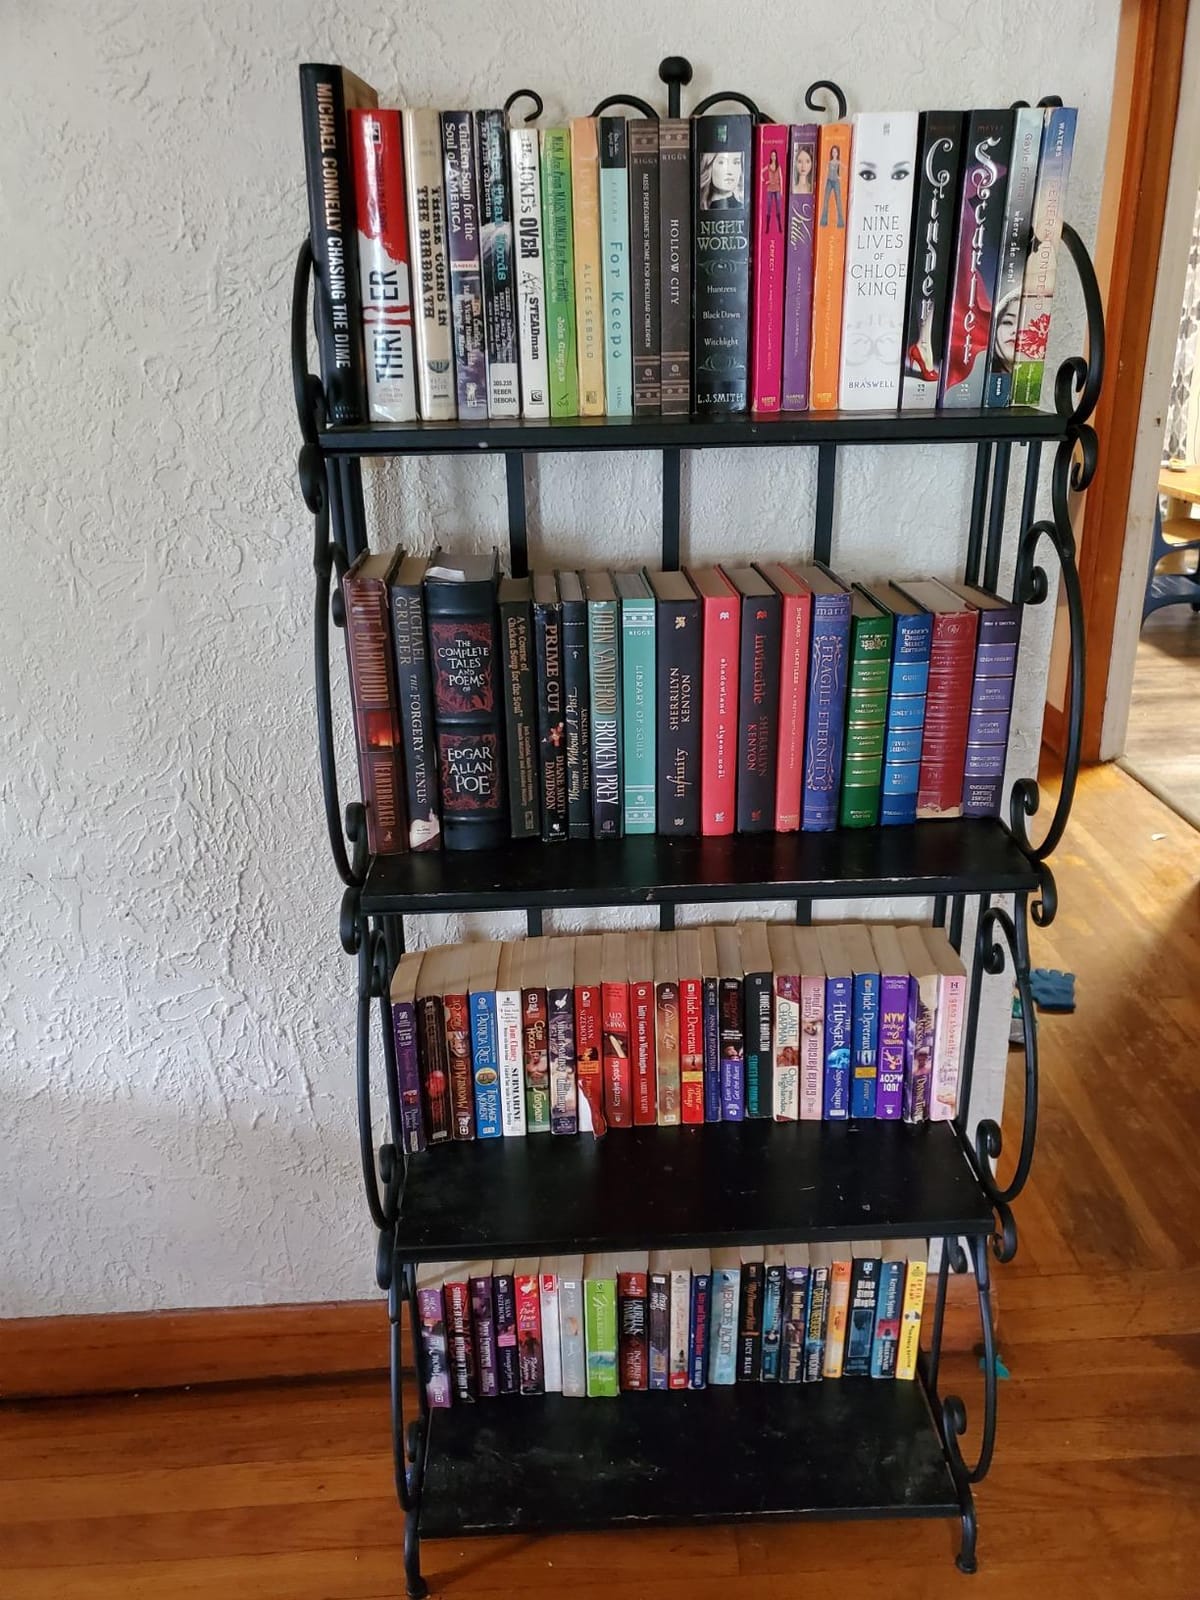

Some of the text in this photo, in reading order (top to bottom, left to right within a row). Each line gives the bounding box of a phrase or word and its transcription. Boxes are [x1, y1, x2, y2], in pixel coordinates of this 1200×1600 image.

[1055, 122, 1065, 157] WATERS
[445, 122, 460, 233] Soul of AMERICA
[459, 122, 474, 241] Chicken Soup for the
[317, 83, 350, 368] MICHAEL CONNELLY CHASING THE DIME
[493, 185, 505, 223] Than
[700, 220, 744, 235] NIGHT
[790, 204, 812, 251] Killer
[863, 216, 899, 230] NINE
[875, 204, 889, 212] THE
[1007, 133, 1033, 283] Gayle where she went
[417, 186, 434, 319] THE BIRDBATH
[431, 186, 448, 327] THREE COINS IN
[520, 218, 539, 258] OVER
[697, 235, 748, 251] WORLD
[857, 235, 904, 249] LIVES
[874, 252, 885, 260] OF
[670, 219, 679, 305] HOLLOW CITY
[851, 264, 906, 279] CHLOE
[584, 264, 593, 359] ALICE SEBOLD
[610, 241, 624, 359] For Keeps
[707, 285, 736, 294] Huntress
[857, 281, 897, 300] KING
[529, 297, 541, 360] STEADman
[557, 316, 566, 339] John
[703, 311, 720, 319] Black
[704, 336, 739, 347] Witchlight
[713, 393, 744, 403] SMITH
[395, 596, 411, 665] GRUBER
[409, 596, 424, 665] MICHAEL
[817, 606, 845, 616] marr
[438, 647, 489, 658] COMPLETE
[447, 658, 481, 669] TALES
[507, 617, 521, 695] Chicken Soup for the
[518, 636, 527, 665] Course
[545, 624, 559, 713] PRIME CUT
[753, 633, 765, 704] invincible
[448, 675, 485, 687] POEMS
[669, 668, 679, 730] SHERRILYN
[681, 675, 690, 722] KENYON
[351, 588, 396, 827] JULIE GARWOOD HEARTBREAKER
[591, 610, 619, 805] JOHN SANDFORD BROKEN PREY
[635, 665, 644, 759] LIBRARY OF SOULS
[716, 658, 727, 756] shadowland alyson
[815, 645, 834, 785] FRAGILE ETERNITY
[410, 694, 427, 804] FORGERY VENUS
[447, 747, 493, 763] EDGAR
[449, 761, 493, 776] ALLAN
[566, 687, 580, 803] Woman Without A Past
[747, 724, 757, 771] KENYON
[758, 716, 768, 776] SHERRILYN
[455, 775, 491, 795] POE
[545, 762, 556, 809] DAVIDSON
[555, 756, 565, 814] DIANE MOTT
[667, 747, 692, 798] infinity
[475, 1013, 491, 1064] PATRICIA RICE
[509, 1025, 518, 1061] Tom Clancy
[686, 996, 699, 1054] Jude Deveraux
[759, 991, 770, 1051] LAURELL HAMILTON
[778, 1002, 790, 1045] CHAPMAN
[788, 1013, 798, 1037] JANET
[830, 1002, 846, 1048] HUNGER
[862, 992, 875, 1050] Jude Deveraux
[512, 1068, 520, 1122] SUBMARINE
[785, 1068, 796, 1086] Only
[477, 1092, 488, 1121] MOMENT
[744, 1357, 752, 1374] BLUE
